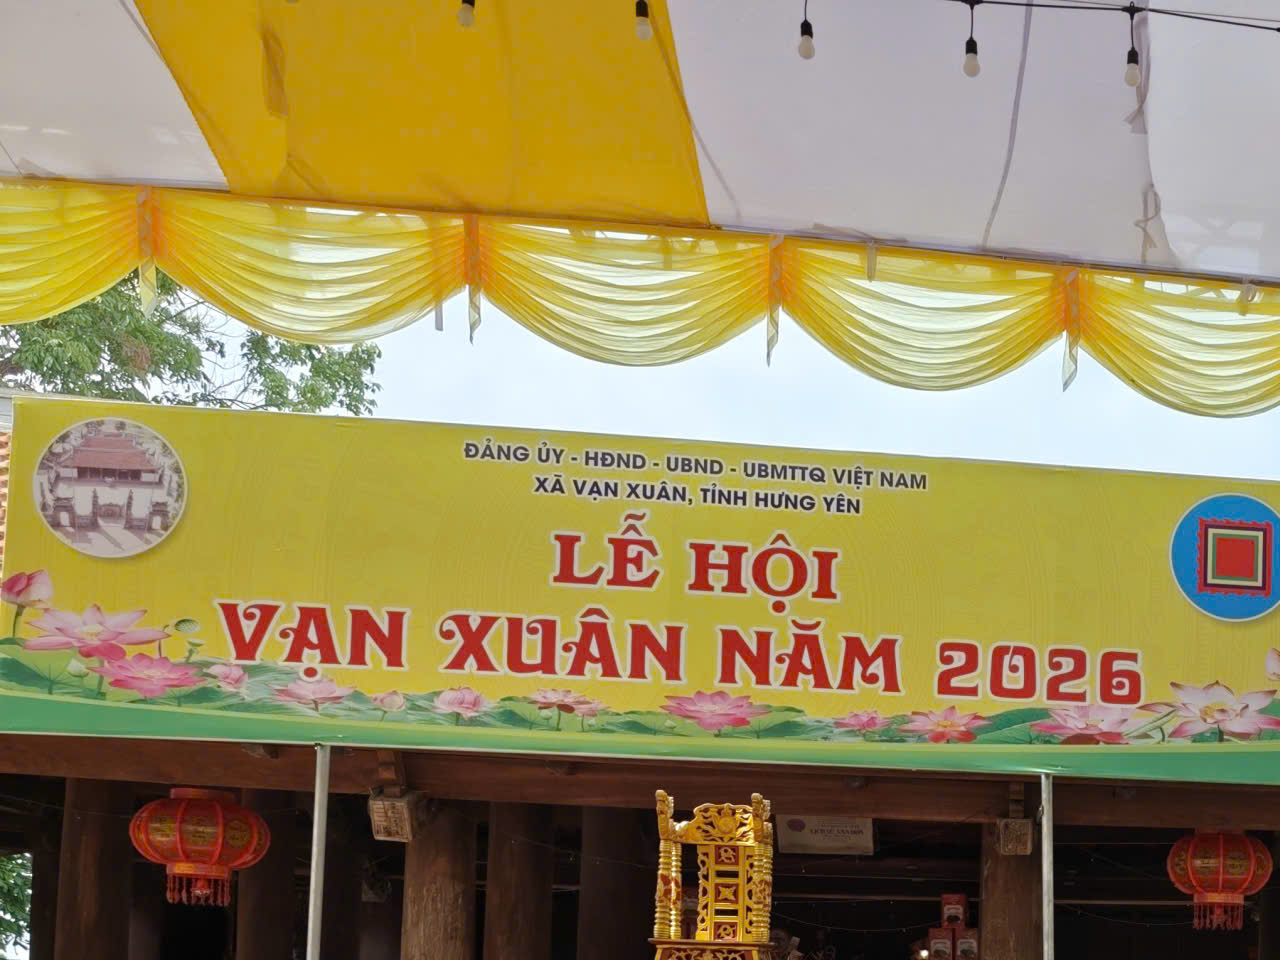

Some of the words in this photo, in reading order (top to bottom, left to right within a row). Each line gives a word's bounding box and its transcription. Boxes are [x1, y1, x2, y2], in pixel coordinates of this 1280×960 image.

[463, 438, 530, 462] ĐẢNG
[537, 441, 565, 464] ỦY
[584, 450, 647, 470] HĐND
[666, 456, 724, 475] UBND
[743, 461, 826, 483] UBMTTQ
[833, 466, 874, 490] VIỆT
[880, 471, 928, 490] NAM
[534, 474, 565, 494] XÃ
[573, 478, 619, 501] VẠN
[626, 480, 693, 505] XUÂN,
[700, 482, 748, 507] TỈNH
[754, 491, 816, 511] HƯNG
[822, 493, 861, 514] YÊN
[552, 512, 660, 589] LỄ
[687, 533, 839, 613] HỘI
[217, 602, 408, 677] VẠN
[439, 607, 684, 681] XUÂN
[718, 618, 900, 693] NĂM
[937, 642, 1142, 705] 2026
